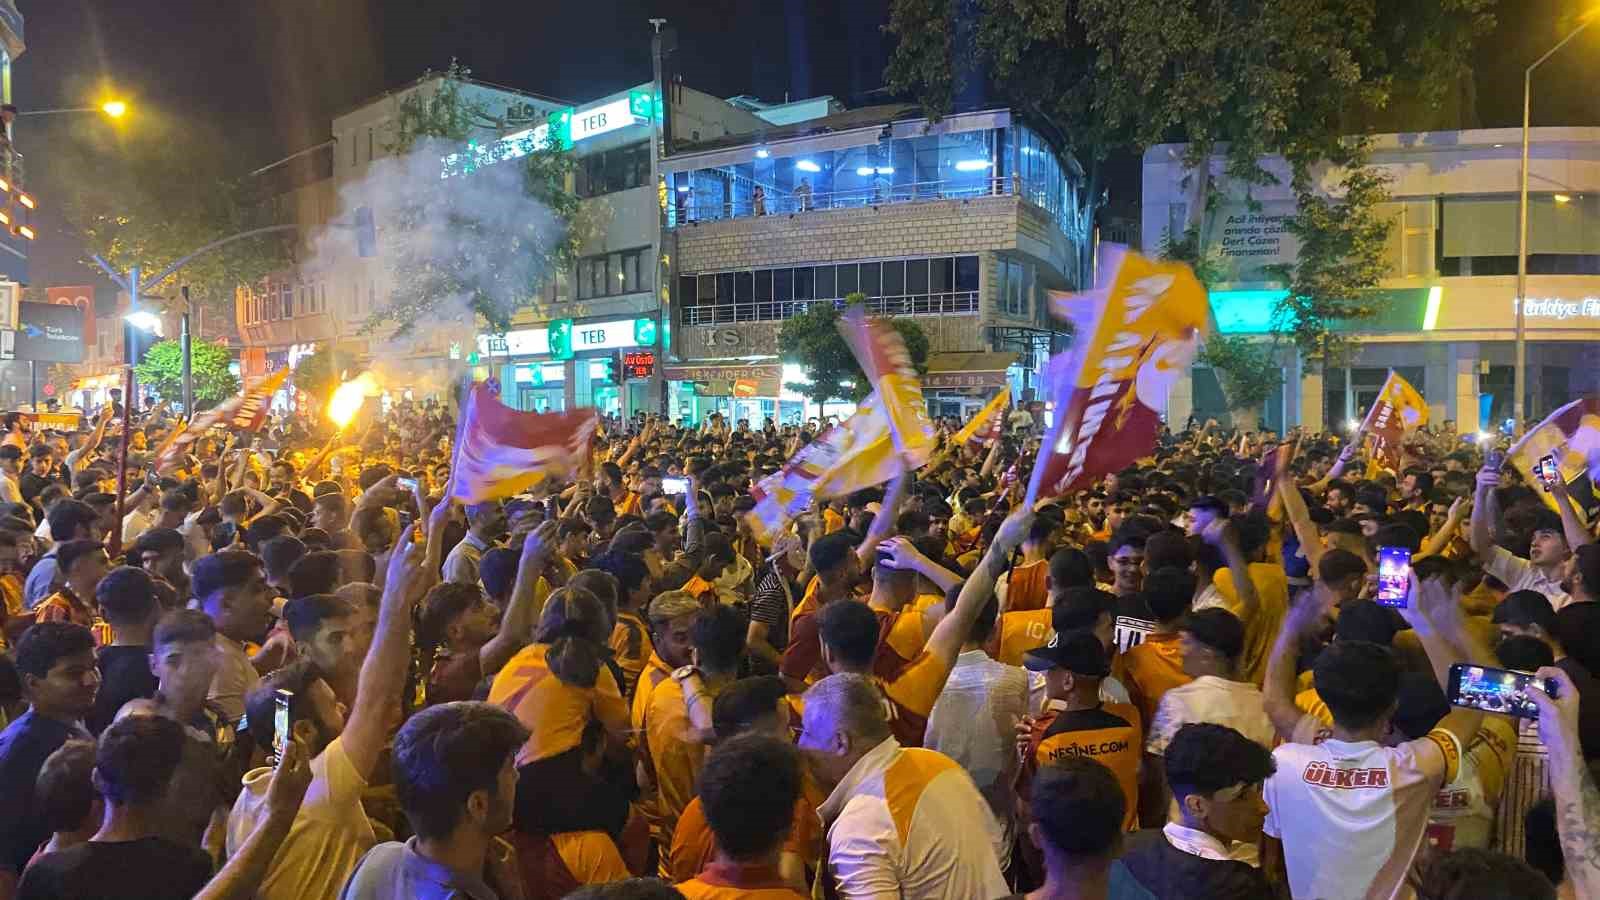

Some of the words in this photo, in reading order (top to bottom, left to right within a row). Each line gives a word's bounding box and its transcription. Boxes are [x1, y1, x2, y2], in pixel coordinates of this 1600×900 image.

[581, 113, 607, 132] TEB
[1222, 237, 1244, 246] Dert
[581, 330, 606, 344] TEB
[1304, 760, 1388, 790] ÜLKER
